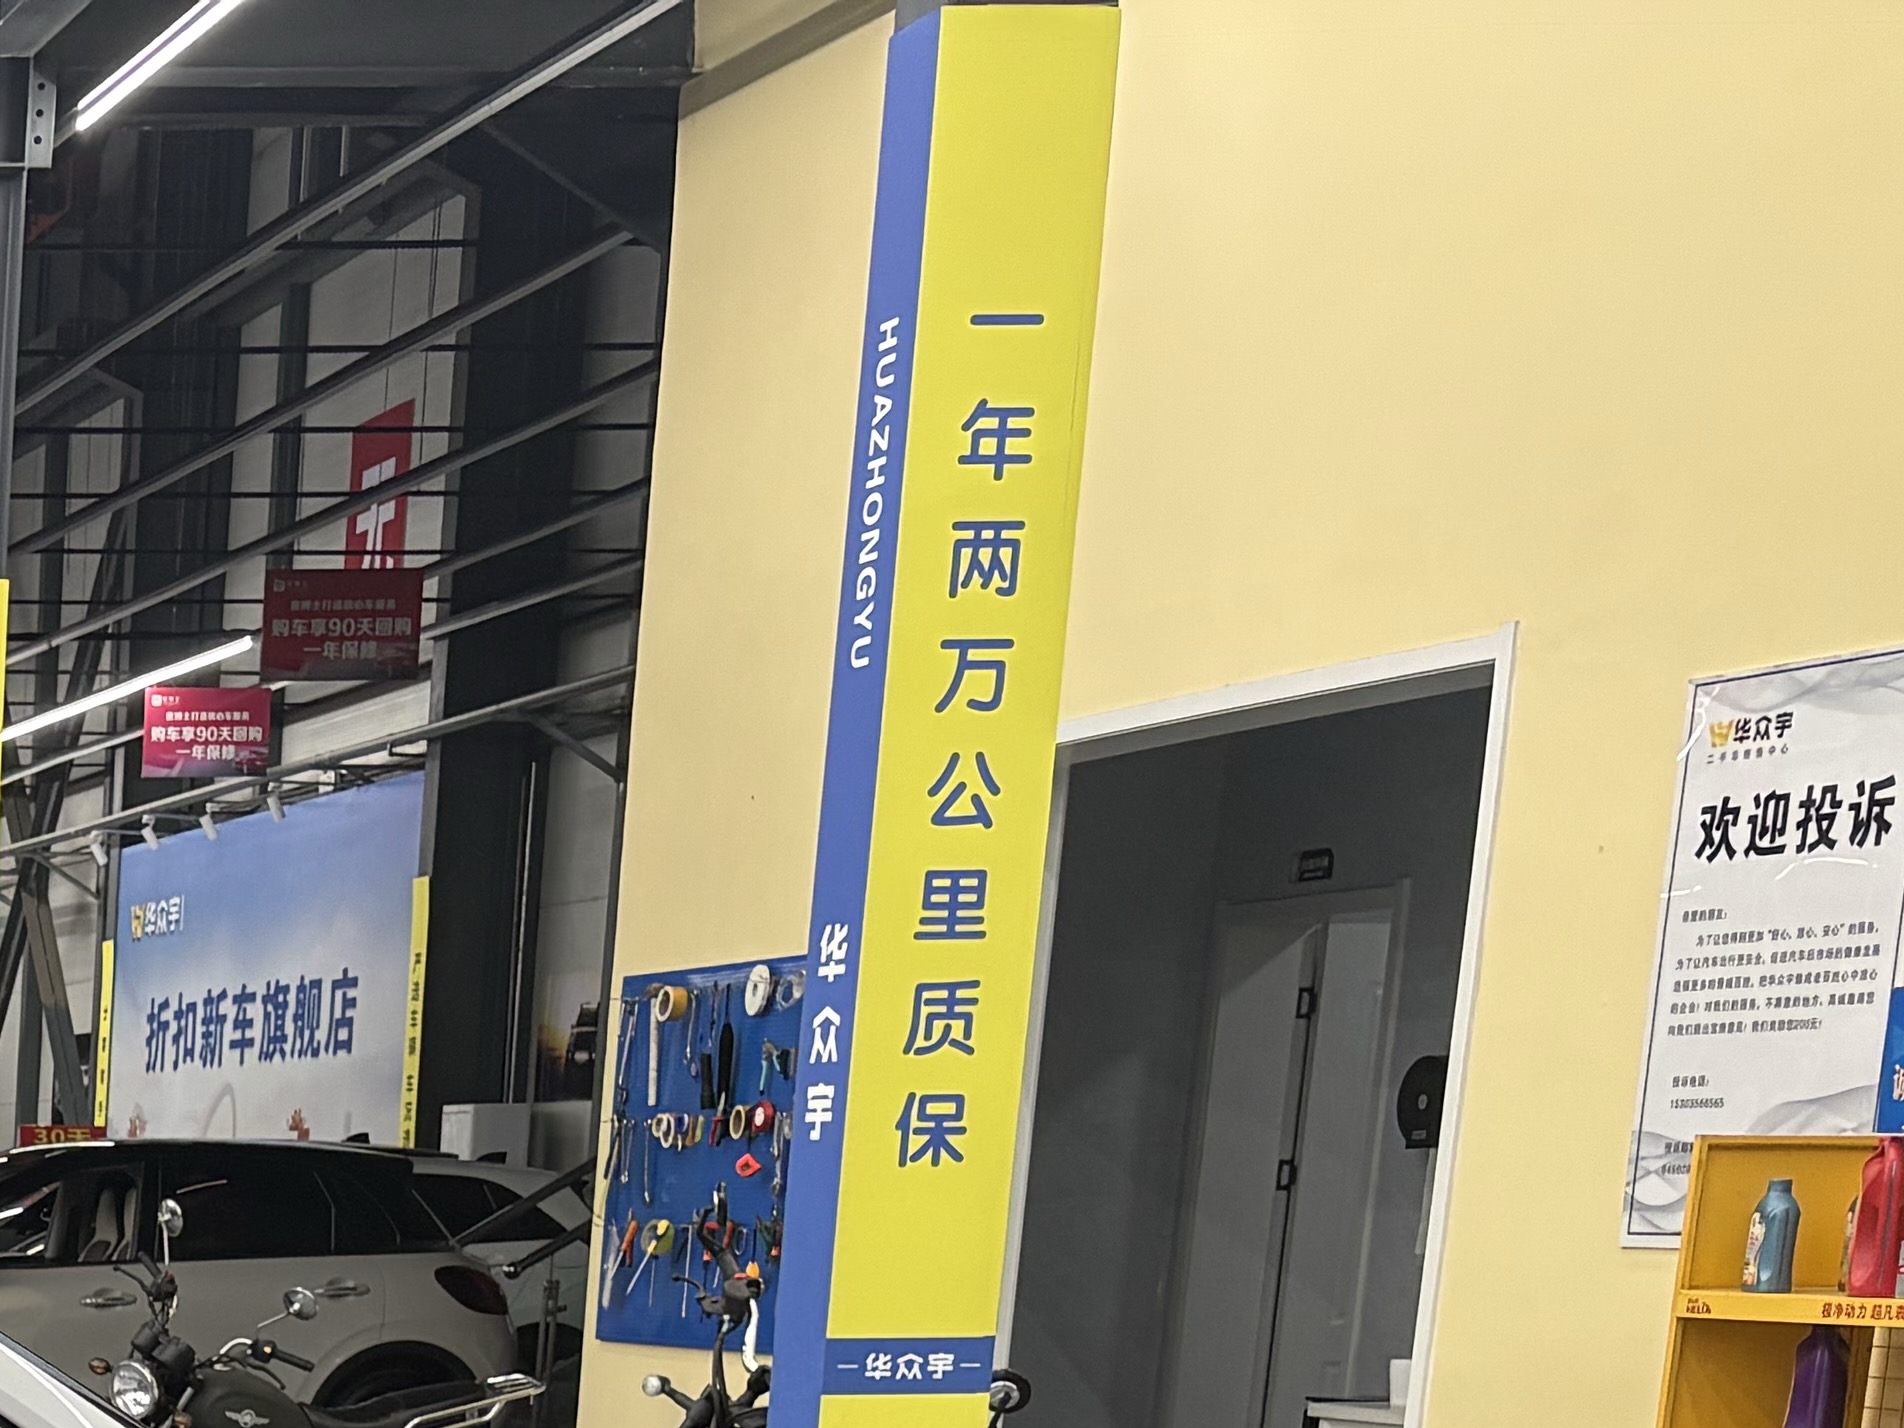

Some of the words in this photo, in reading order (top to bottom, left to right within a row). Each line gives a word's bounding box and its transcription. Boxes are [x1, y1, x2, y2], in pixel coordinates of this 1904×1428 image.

[850, 316, 900, 669] HUAZHONGYU
[271, 618, 412, 637] 购车享90天回购
[303, 641, 378, 660] 一年保修
[151, 726, 262, 742] 购车享90天回购
[894, 313, 1045, 1168] 一年两万公里质保
[1733, 712, 1794, 744] 华众宇
[175, 745, 235, 760] 一年保修
[1695, 775, 1897, 864] 欢迎投诉
[145, 967, 360, 1075] 折扣新车旗舰店
[804, 922, 849, 1141] 华众宇
[864, 1351, 957, 1381] 华众宇
